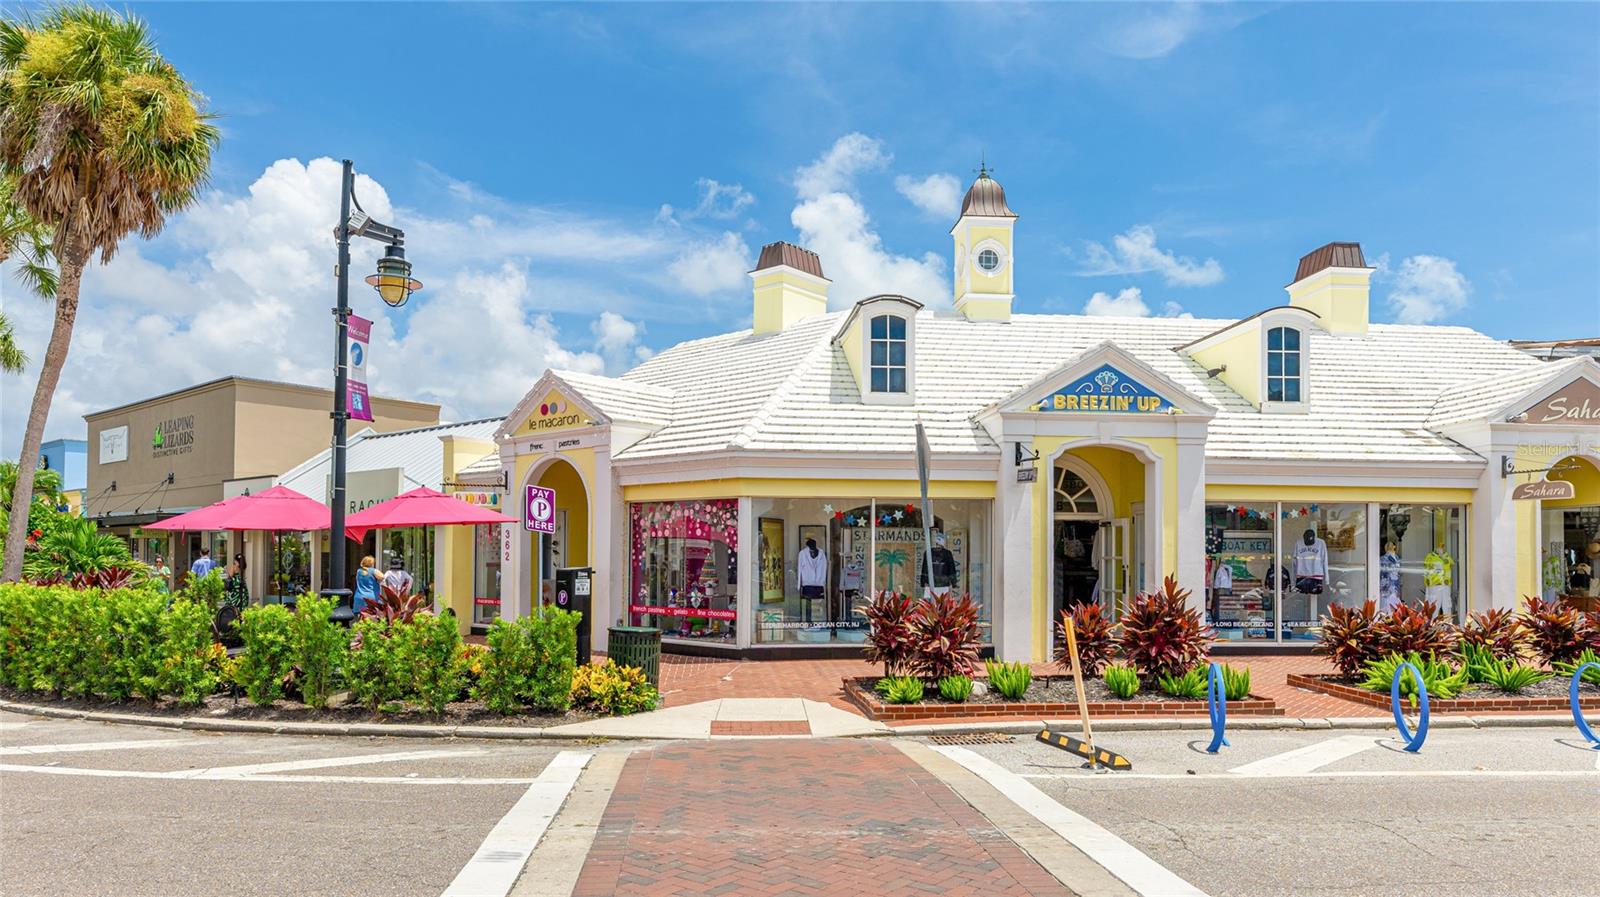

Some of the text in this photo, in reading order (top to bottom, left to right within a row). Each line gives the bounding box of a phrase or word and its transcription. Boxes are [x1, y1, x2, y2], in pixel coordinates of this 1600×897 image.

[1054, 394, 1161, 411] BREEZIN' UP
[164, 415, 194, 434] LEAPING
[529, 414, 580, 430] le macaron
[162, 430, 194, 449] LIZARDS
[558, 440, 580, 448] pastries
[153, 449, 179, 458] DISTINCTIVE
[532, 488, 550, 498] PAY
[1520, 484, 1566, 498] Sahara
[537, 502, 547, 517] P
[528, 520, 554, 531] HERE
[1250, 541, 1269, 550] KEY
[648, 606, 666, 614] pastries
